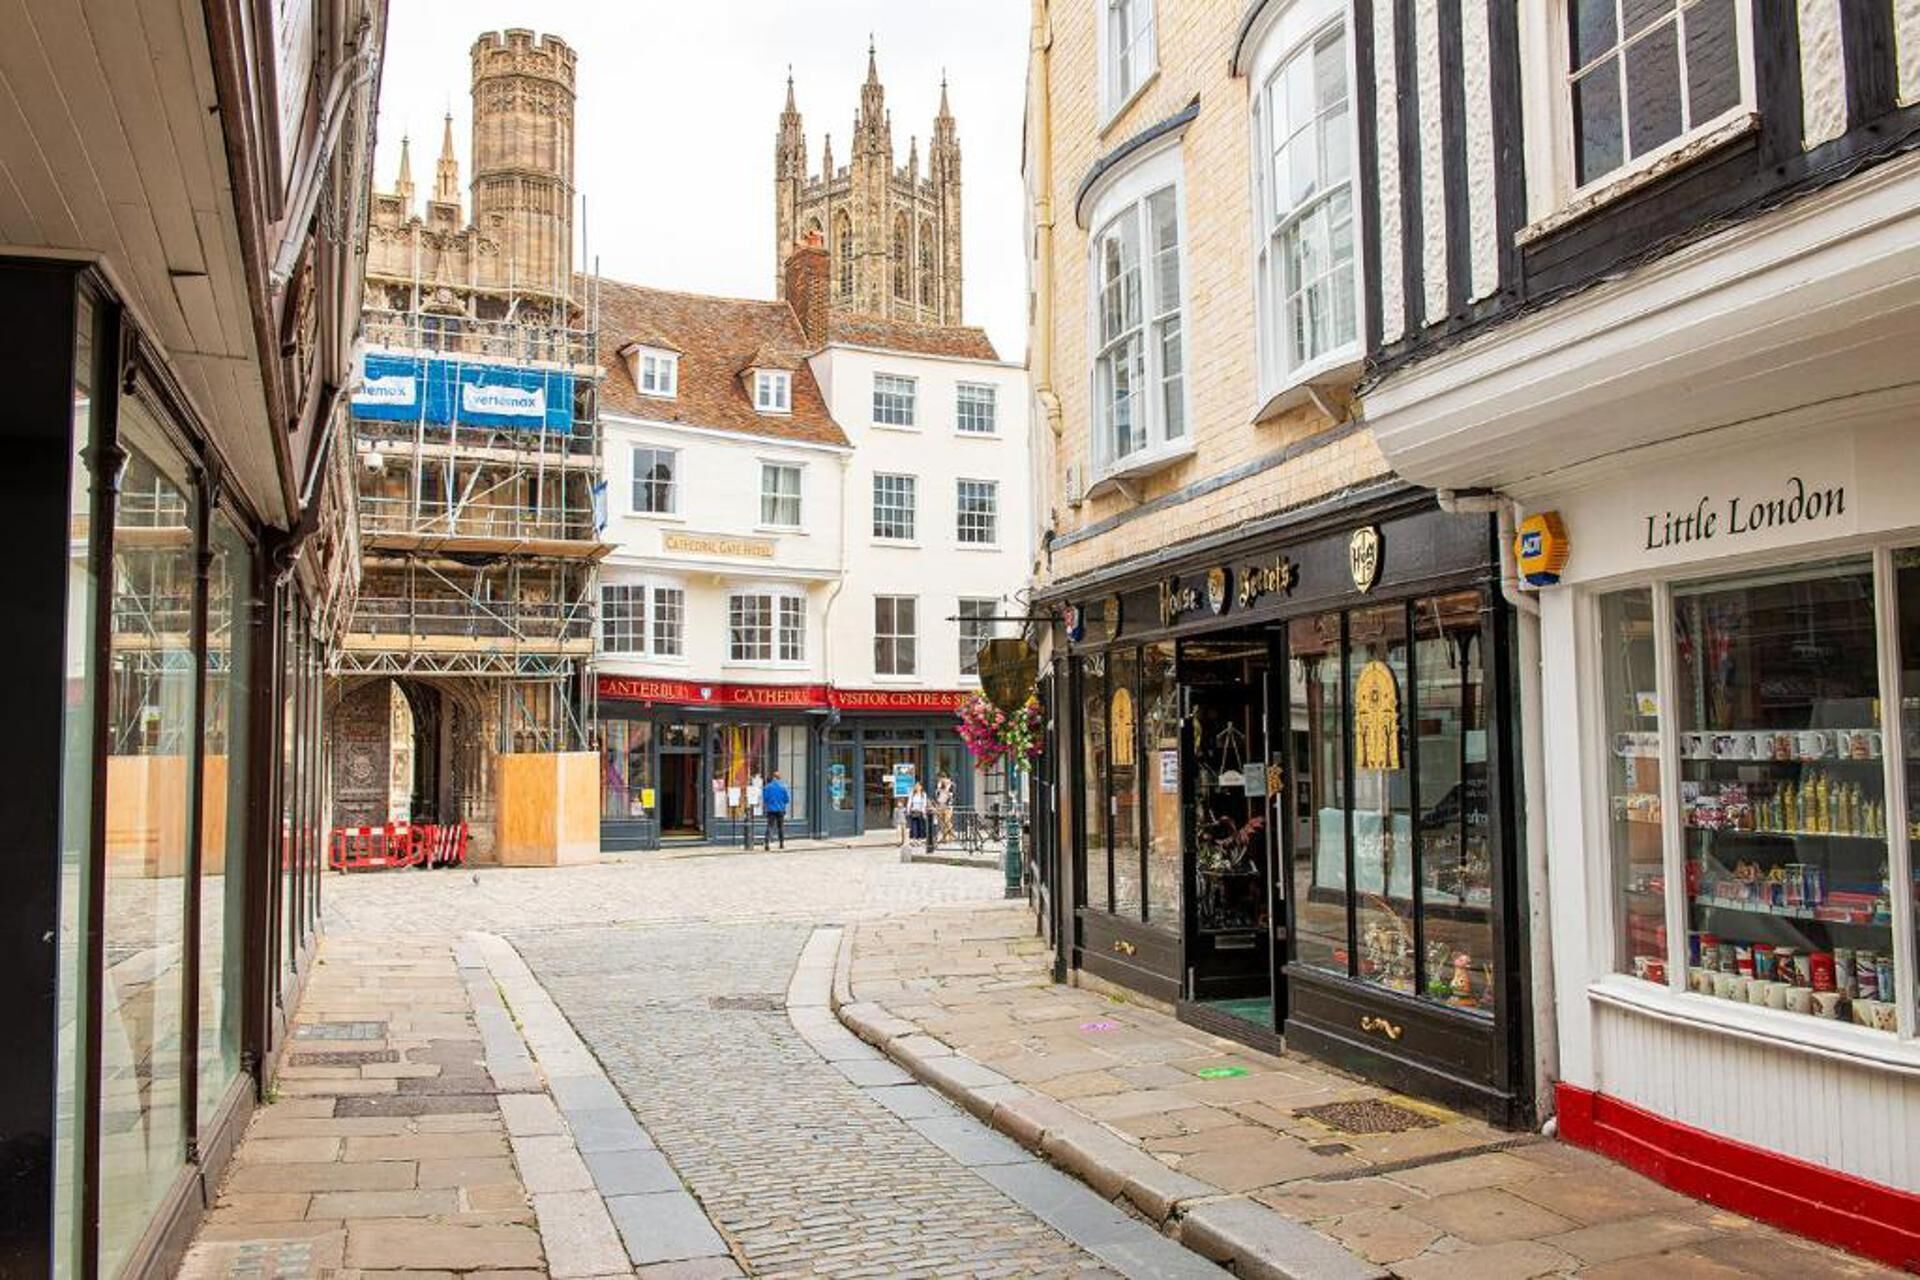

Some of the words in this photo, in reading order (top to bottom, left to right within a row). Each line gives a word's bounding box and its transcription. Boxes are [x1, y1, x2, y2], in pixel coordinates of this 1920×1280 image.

[1645, 496, 1717, 550] Little
[1728, 477, 1845, 535] London
[1159, 576, 1199, 627] House
[1238, 555, 1291, 609] Secrets
[839, 693, 888, 705] VISITOR
[890, 693, 940, 705] CENTRE
[941, 693, 951, 705] &
